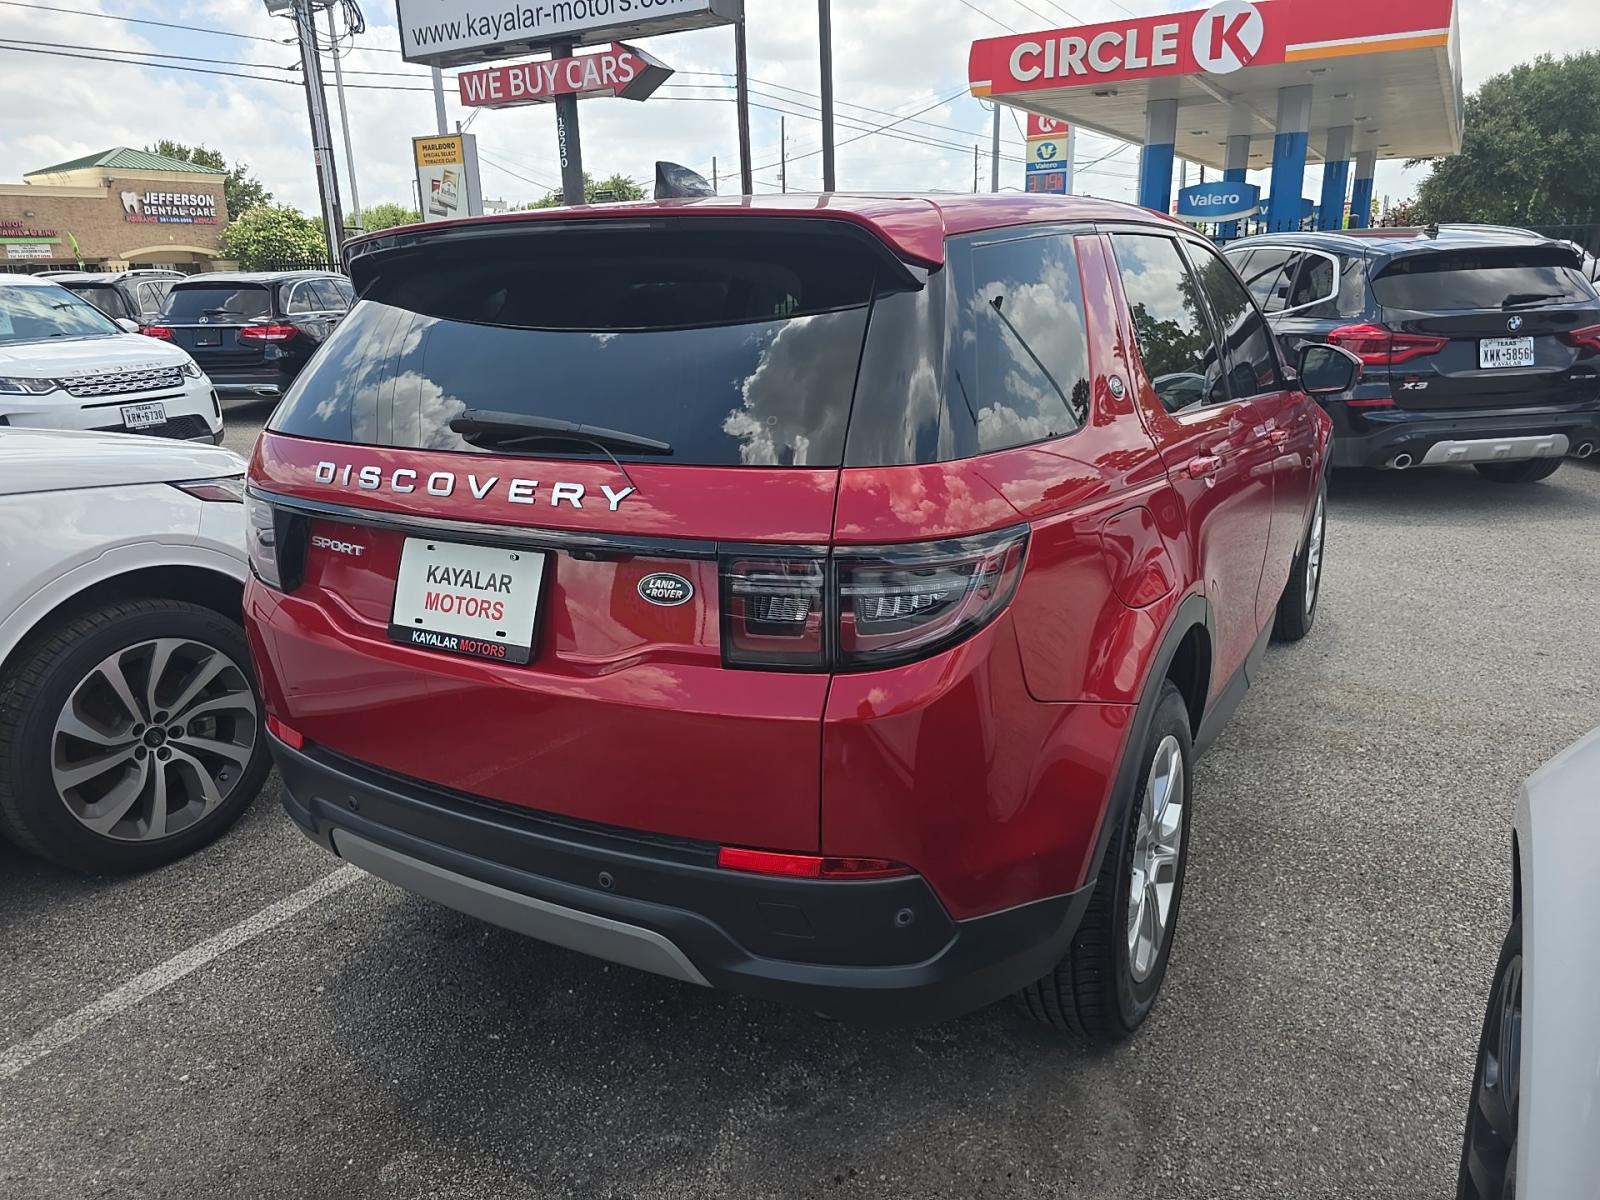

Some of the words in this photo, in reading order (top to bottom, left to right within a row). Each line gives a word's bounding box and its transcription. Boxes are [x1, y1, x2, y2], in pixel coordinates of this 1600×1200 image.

[1009, 22, 1180, 82] CIRCLE
[1208, 11, 1253, 67] K
[463, 72, 503, 101] WE
[508, 63, 561, 97] BUY
[566, 53, 635, 88] CARS
[422, 142, 456, 151] MARLBORO
[558, 117, 568, 168] 16230
[142, 192, 215, 207] JEFFERSON
[144, 205, 186, 215] DENTAL
[190, 207, 216, 216] CARE
[1189, 193, 1240, 207] Valero
[1400, 382, 1429, 390] X3
[315, 460, 637, 511] DISCOVERY
[311, 535, 365, 556] SPORT
[426, 564, 513, 594] KAYALAR
[424, 591, 505, 621] MOTORS
[412, 630, 458, 649] KAYALAR
[459, 639, 506, 657] MOTORS
